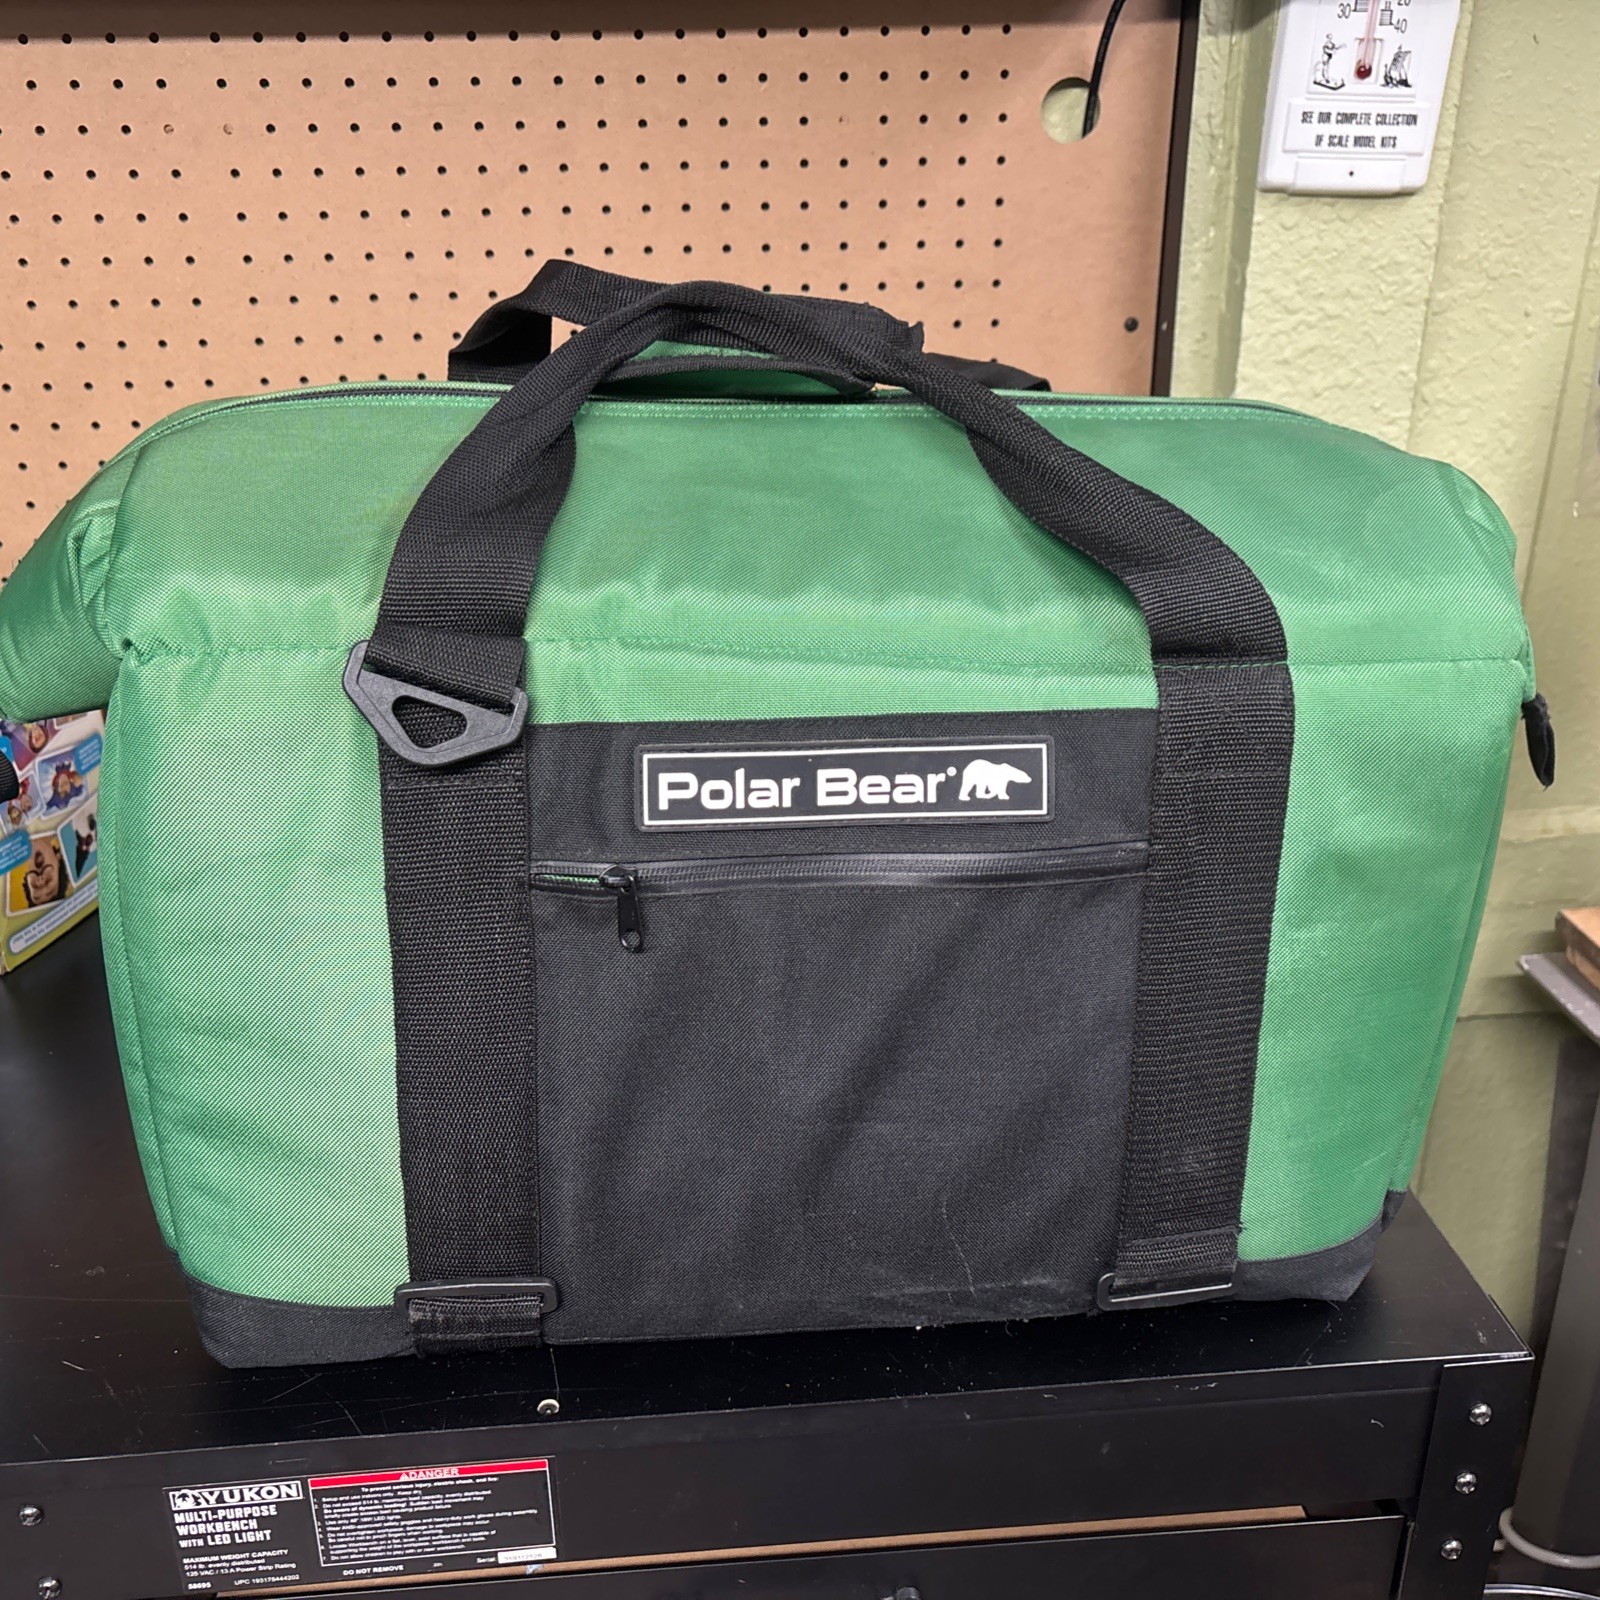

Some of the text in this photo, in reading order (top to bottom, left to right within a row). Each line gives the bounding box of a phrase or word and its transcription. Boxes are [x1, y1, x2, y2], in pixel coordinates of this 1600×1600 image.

[1337, 3, 1351, 19] 30
[1394, 18, 1408, 34] 40
[1301, 111, 1418, 126] SEE OUR COMPLETE COLLECTION
[1314, 134, 1397, 149] OF SCALE MODEL KITS
[657, 766, 800, 810] Polar
[409, 1467, 460, 1480] DANGER
[201, 1483, 298, 1505] YUKON
[174, 1504, 278, 1524] MULTI-PURPOSE
[176, 1519, 258, 1536] WORKBENCH
[179, 1530, 271, 1548] WITH LED LIGHT
[182, 1549, 289, 1564] MAXIMUM WEIGHT CAPACITY
[372, 1564, 404, 1573] REMOVE
